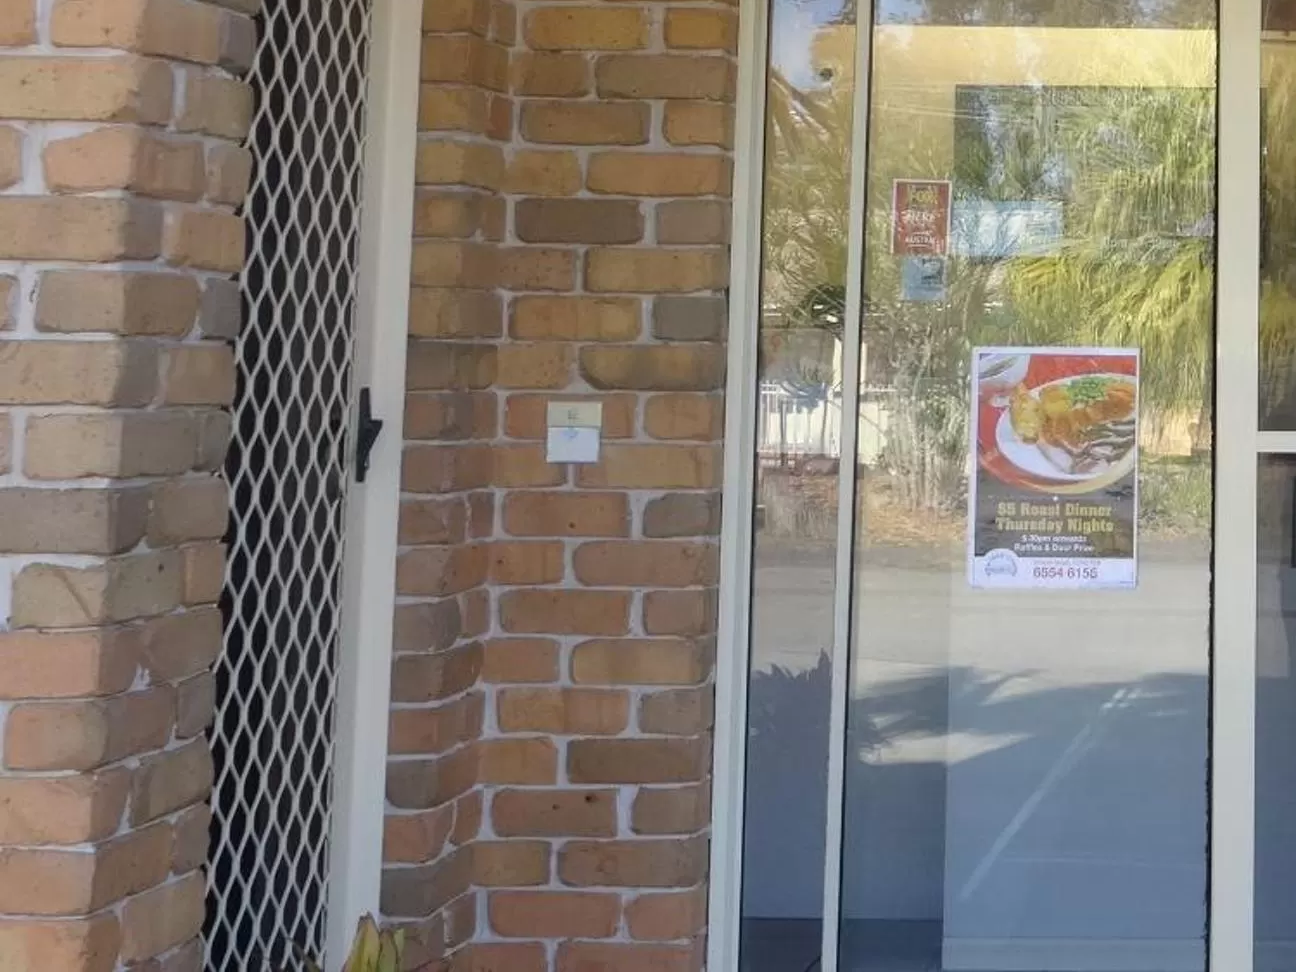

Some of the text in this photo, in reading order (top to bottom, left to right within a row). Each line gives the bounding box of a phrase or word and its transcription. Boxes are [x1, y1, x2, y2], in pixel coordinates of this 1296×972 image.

[1020, 502, 1060, 517] Roast
[1065, 503, 1112, 518] Dinner
[996, 517, 1114, 534] Thursday Nights
